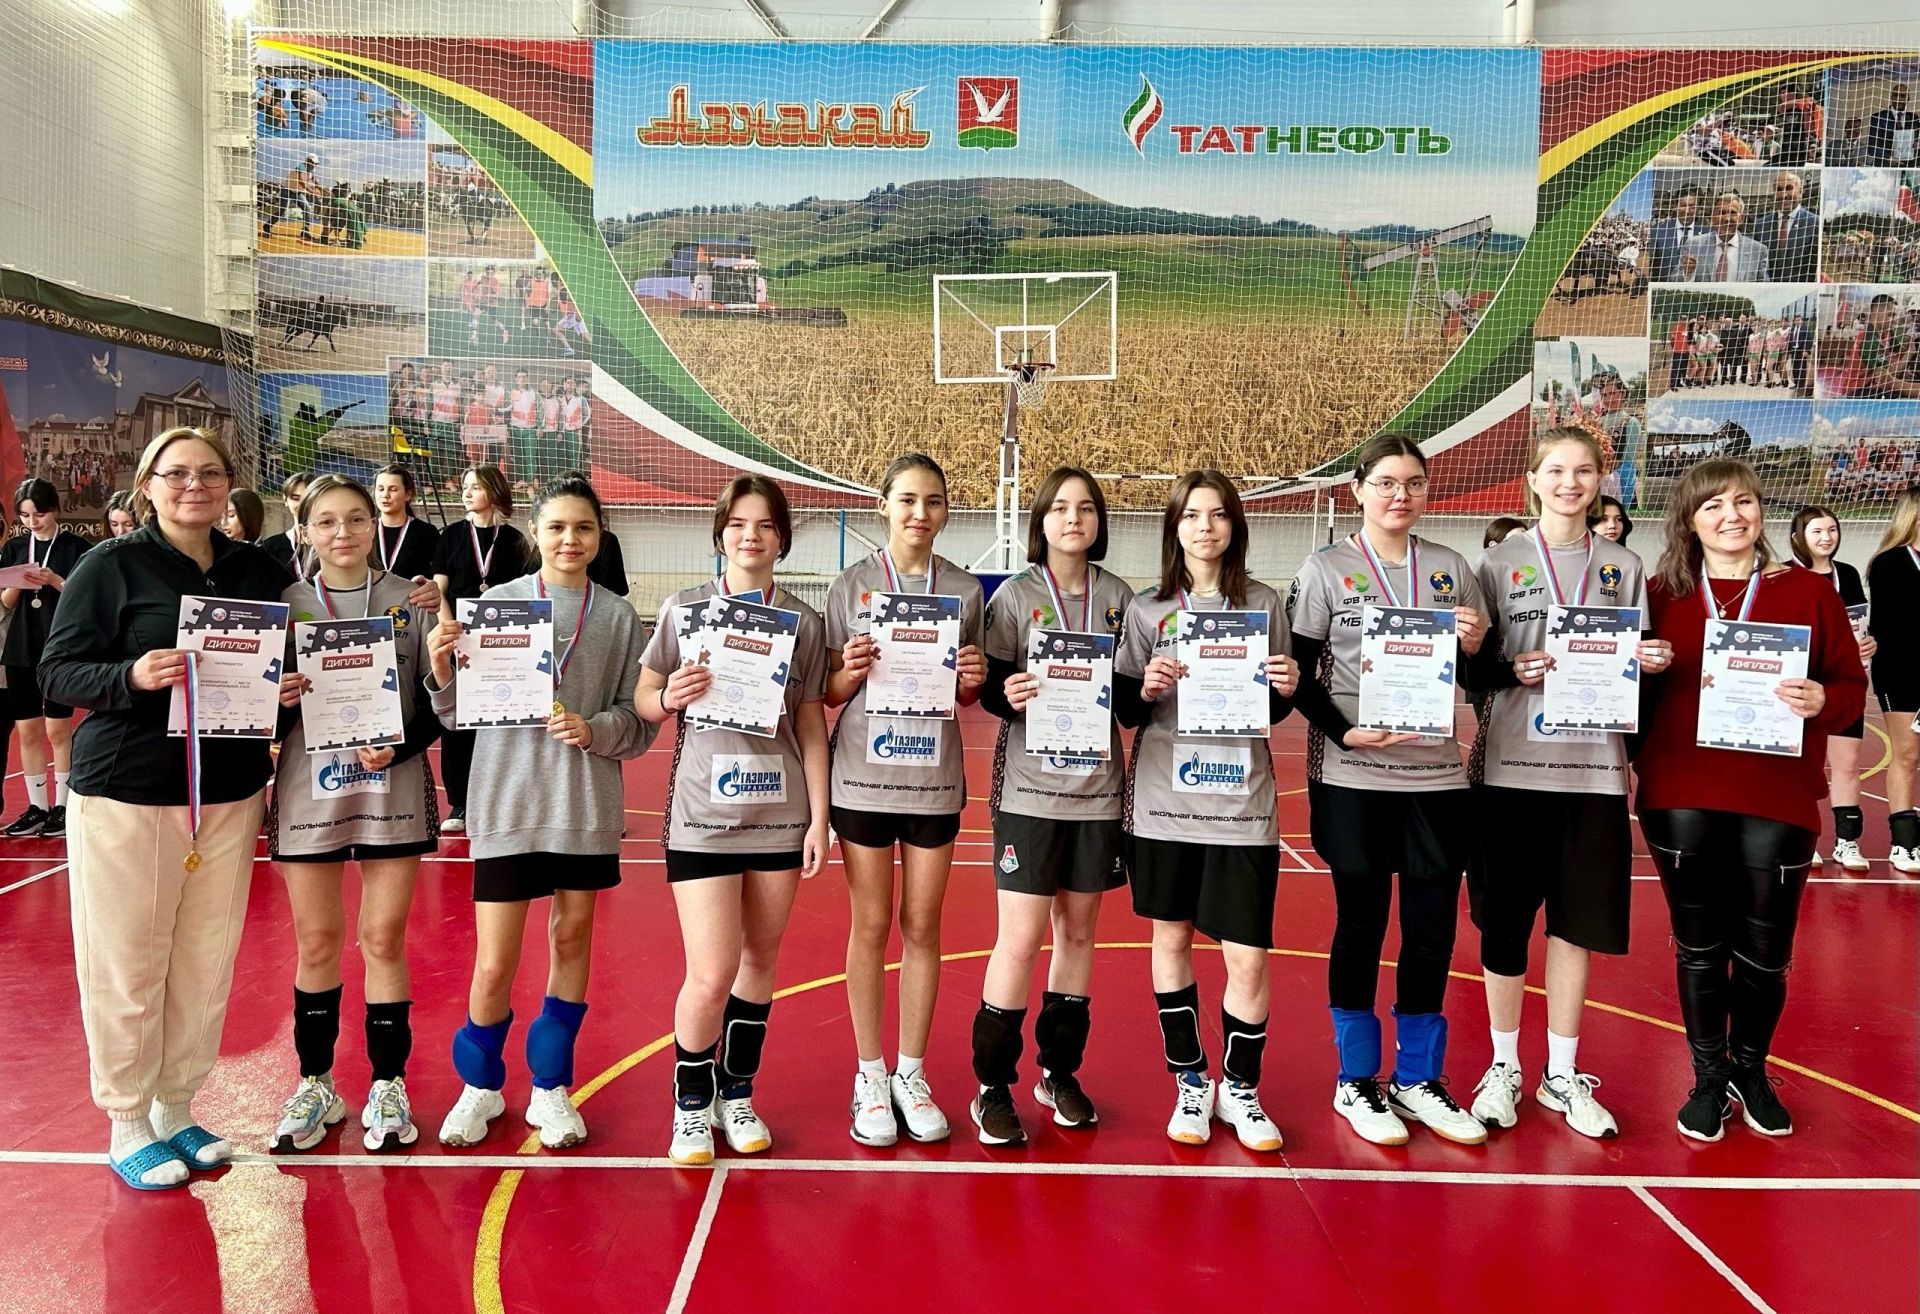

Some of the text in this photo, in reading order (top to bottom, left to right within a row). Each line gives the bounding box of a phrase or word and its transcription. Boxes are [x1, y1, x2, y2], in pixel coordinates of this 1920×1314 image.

[1170, 125, 1452, 156] ТАТНЕФТЬ
[1530, 587, 1545, 595] РТ
[1364, 595, 1379, 603] РТ
[1433, 595, 1456, 603] ШВЛ
[1508, 609, 1548, 624] МБОУ
[895, 631, 936, 640] ДИПЛОМ
[206, 639, 257, 651] ДИПЛОМ
[483, 637, 528, 646] ДИПЛОМ
[727, 638, 770, 653] ДИПЛОМ
[1202, 648, 1245, 656] ДИПЛОМ
[1387, 644, 1431, 654] ДИПЛОМ
[1571, 642, 1614, 652] ДИПЛОМ
[325, 656, 371, 668] ДИПЛОМ
[1730, 659, 1780, 671] ДИПЛОМ
[1050, 668, 1090, 678] ДИПЛОМ
[894, 735, 936, 747] ГАЗПРОМ
[894, 747, 935, 755] ТРАНСГАЗ
[1201, 762, 1245, 775] ГАЗПРОМ
[1341, 758, 1386, 770] ШКОЛЬНАЯ
[1501, 759, 1546, 768] ШКОЛЬНАЯ
[1548, 762, 1609, 771] ВОЛЕЙБОЛЬНАЯ
[741, 771, 781, 783] ГАЗПРОМ
[1201, 775, 1245, 783] ТРАНСГАЗ
[843, 778, 881, 789] ШКОЛЬНАЯ
[1017, 787, 1057, 797] ШКОЛЬНАЯ
[394, 813, 414, 821] ЛИГА
[1149, 810, 1190, 820] ШКОЛЬНАЯ
[1192, 814, 1253, 823] ВОЛЕЙБОЛЬНАЯ
[683, 821, 727, 831] ШКОЛЬНАЯ
